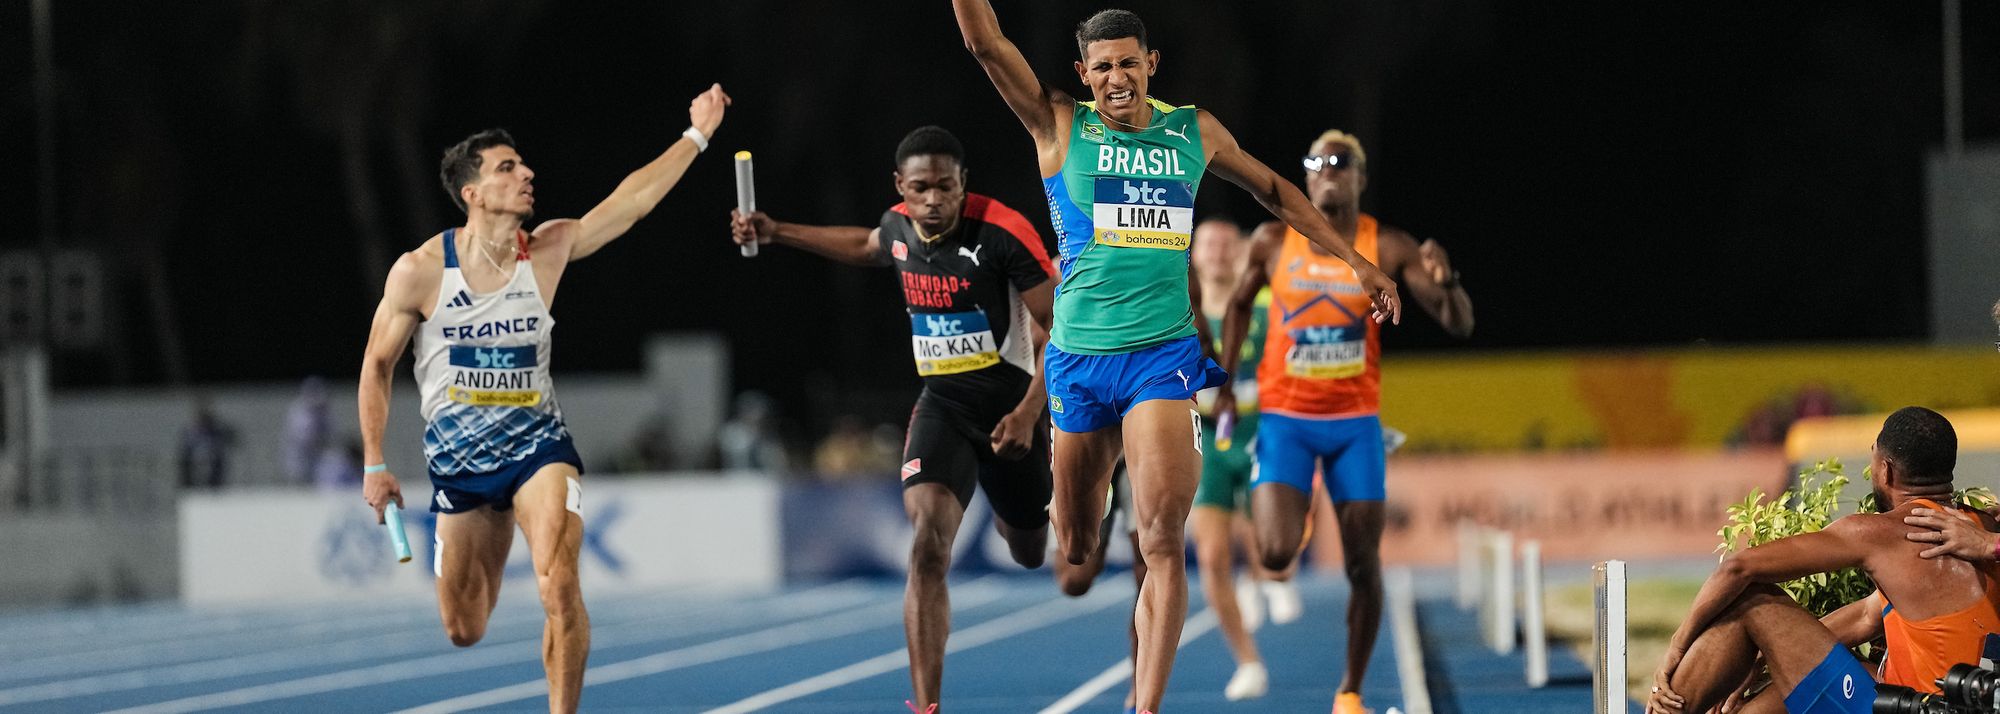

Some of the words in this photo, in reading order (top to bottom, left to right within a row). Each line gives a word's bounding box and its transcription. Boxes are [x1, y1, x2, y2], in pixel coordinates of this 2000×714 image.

[1097, 144, 1185, 175] BRASIL
[1123, 180, 1167, 205] btc
[1117, 207, 1171, 229] LIMA
[904, 289, 953, 308] TOBAGO
[442, 317, 539, 340] FRANCE
[925, 315, 964, 336] btc
[919, 340, 942, 357] Mc
[946, 335, 984, 355] KAY
[475, 347, 515, 368] btc
[454, 370, 534, 389] ANDANT
